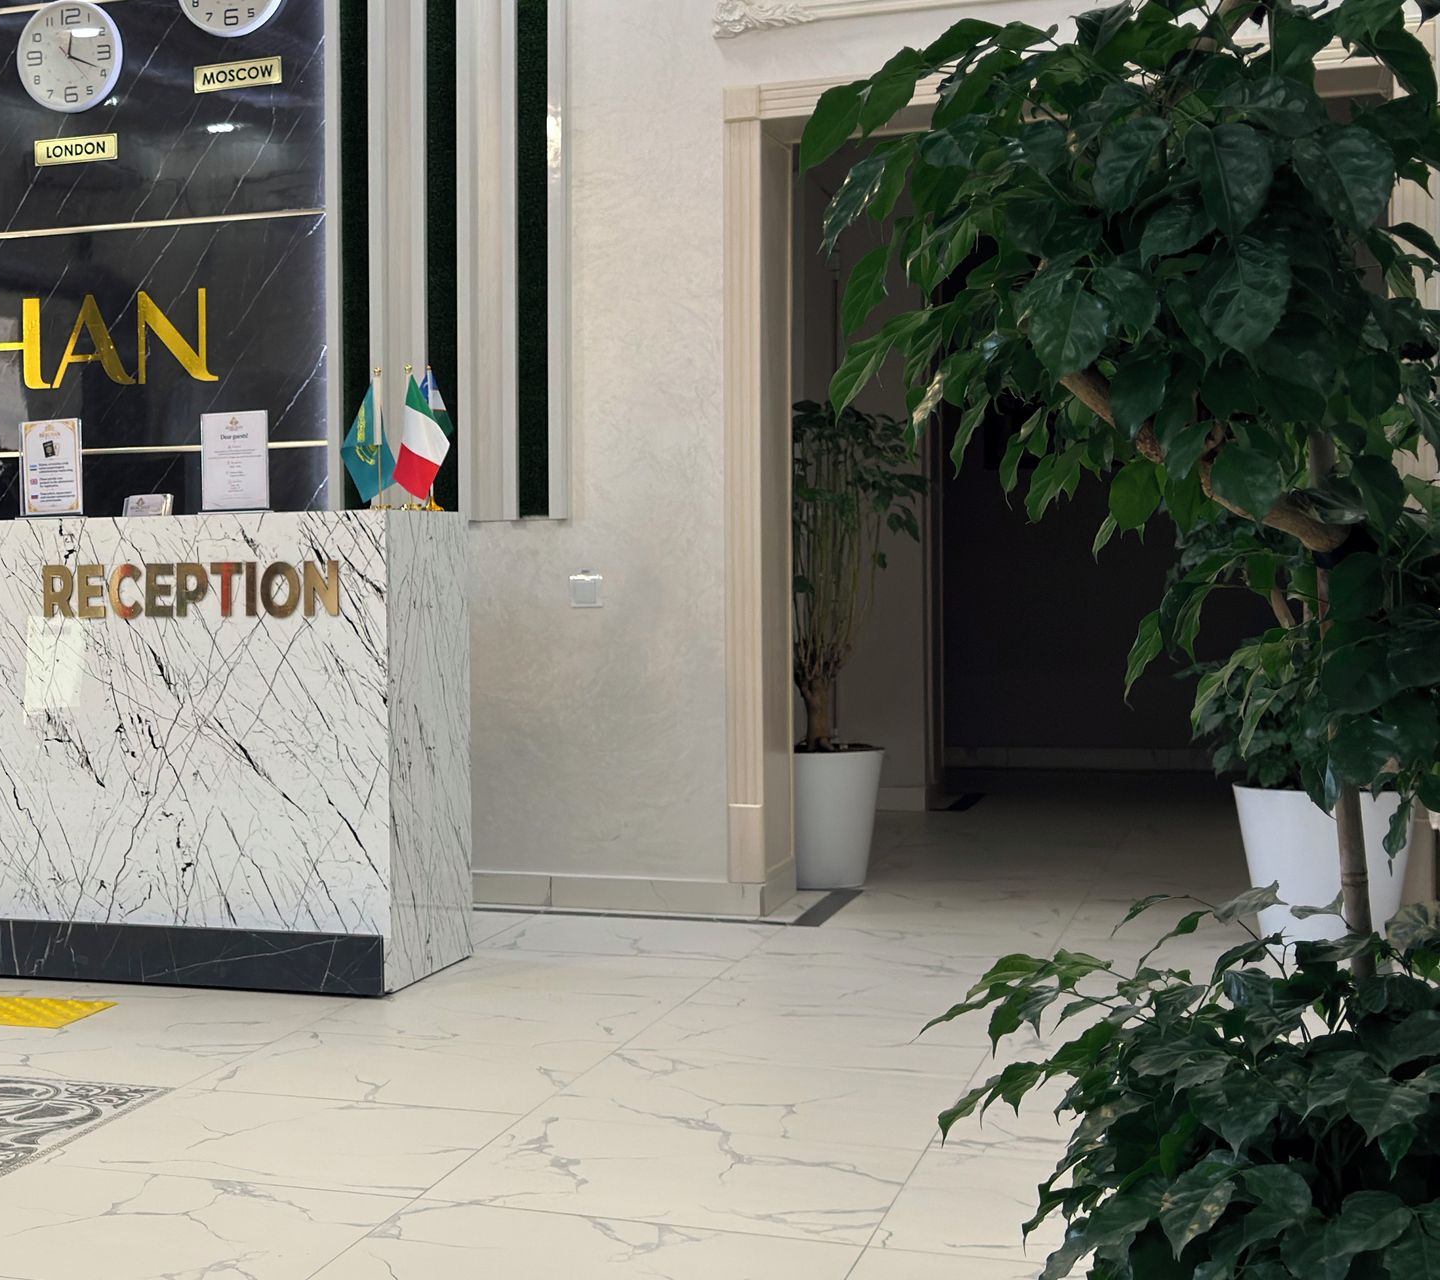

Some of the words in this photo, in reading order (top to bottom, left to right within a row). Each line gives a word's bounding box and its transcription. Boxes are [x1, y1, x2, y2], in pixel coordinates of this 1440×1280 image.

[60, 8, 81, 25] 12
[224, 9, 238, 26] 6
[26, 50, 42, 67] 9
[97, 44, 110, 61] 3
[202, 64, 273, 85] MOSCOW
[64, 86, 78, 103] 6
[46, 141, 106, 158] LONDON
[41, 560, 340, 619] RECEPTION
